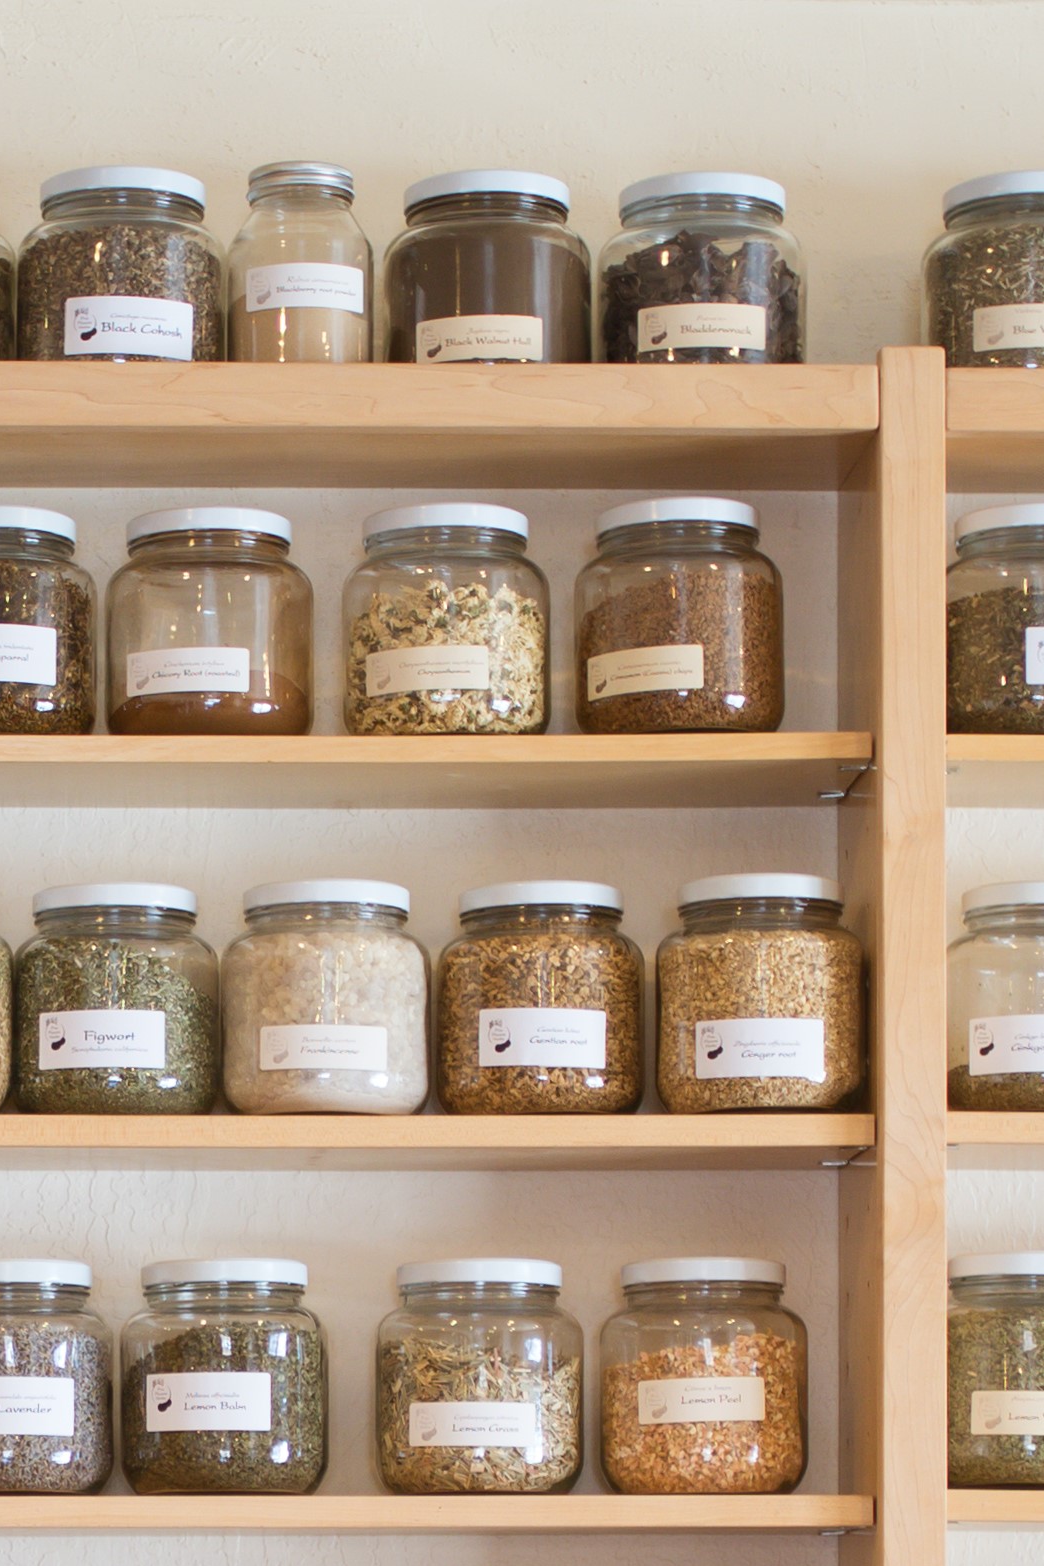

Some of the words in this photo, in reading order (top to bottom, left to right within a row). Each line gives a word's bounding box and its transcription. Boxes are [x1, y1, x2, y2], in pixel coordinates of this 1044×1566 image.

[101, 321, 136, 334] Black
[140, 323, 183, 339] Cohosh
[445, 338, 472, 347] Black
[83, 1030, 135, 1044] Figwort
[681, 1395, 716, 1405] Lemon
[718, 1393, 742, 1404] Peel
[184, 1402, 217, 1411] Lemon
[1008, 1412, 1041, 1421] Lemon
[452, 1423, 486, 1432] Lemon
